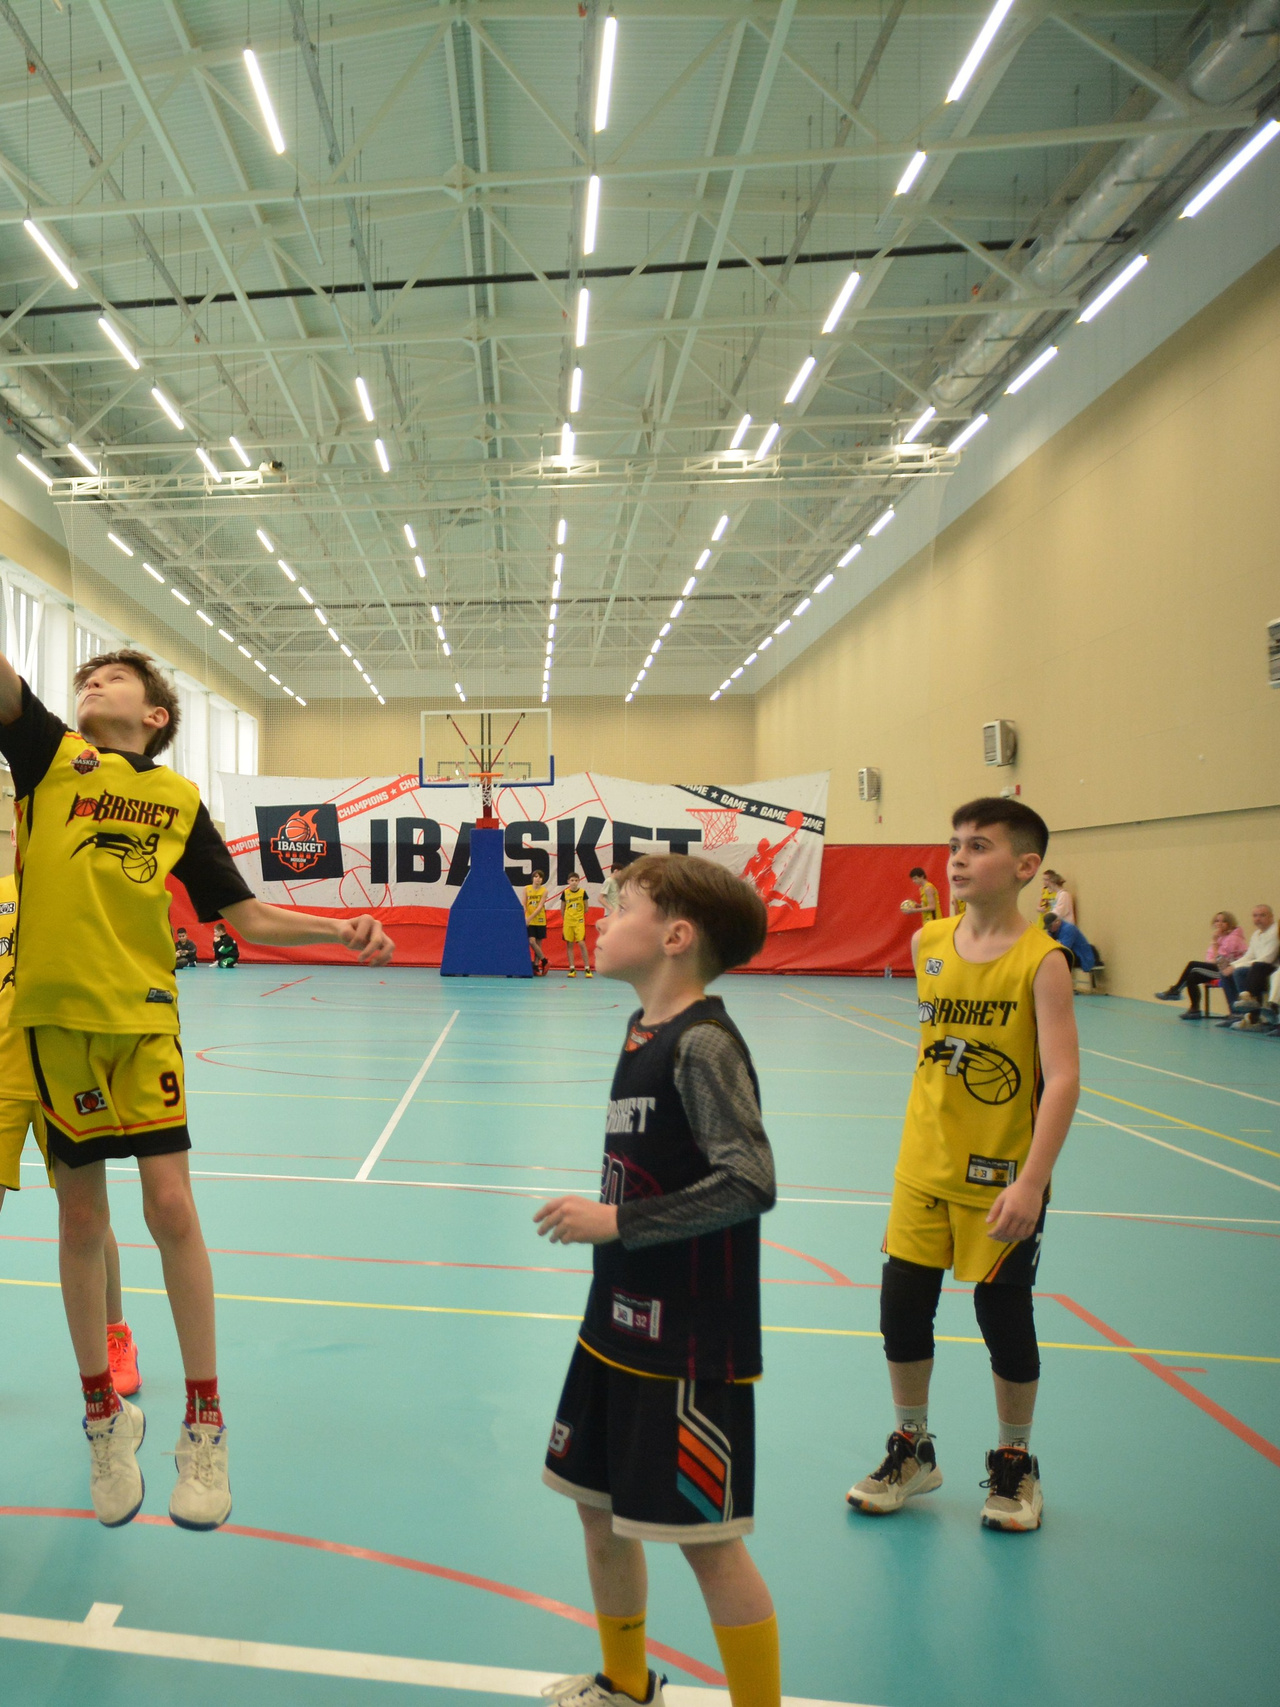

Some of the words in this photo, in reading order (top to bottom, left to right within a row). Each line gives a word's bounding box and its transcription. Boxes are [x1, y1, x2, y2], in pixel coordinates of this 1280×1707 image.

[65, 788, 180, 830] IBASKET
[337, 790, 389, 818] CHAMPIONS
[720, 793, 748, 811] GAME
[760, 806, 787, 821] GAME
[141, 832, 160, 856] 9
[278, 841, 323, 853] IBASKET
[944, 1034, 966, 1077] 7
[159, 1070, 180, 1108] 9
